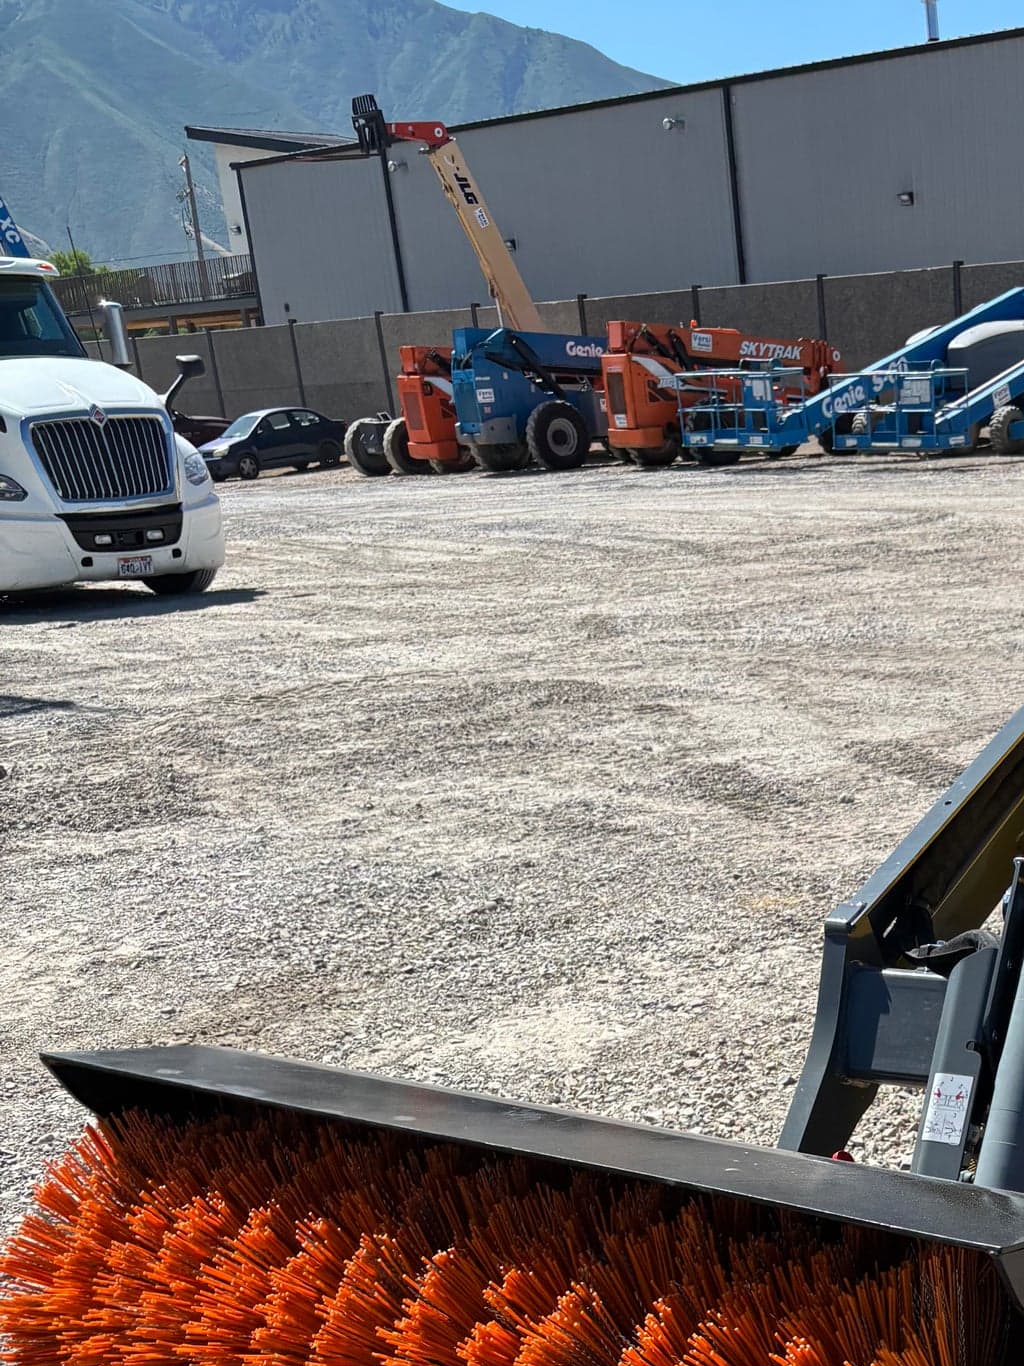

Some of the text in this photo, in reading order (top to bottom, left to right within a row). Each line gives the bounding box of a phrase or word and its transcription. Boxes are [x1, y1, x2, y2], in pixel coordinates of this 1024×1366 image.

[454, 173, 479, 204] JLG
[566, 341, 603, 358] Genie
[740, 341, 803, 360] SKYTRAK
[822, 384, 866, 419] Genie
